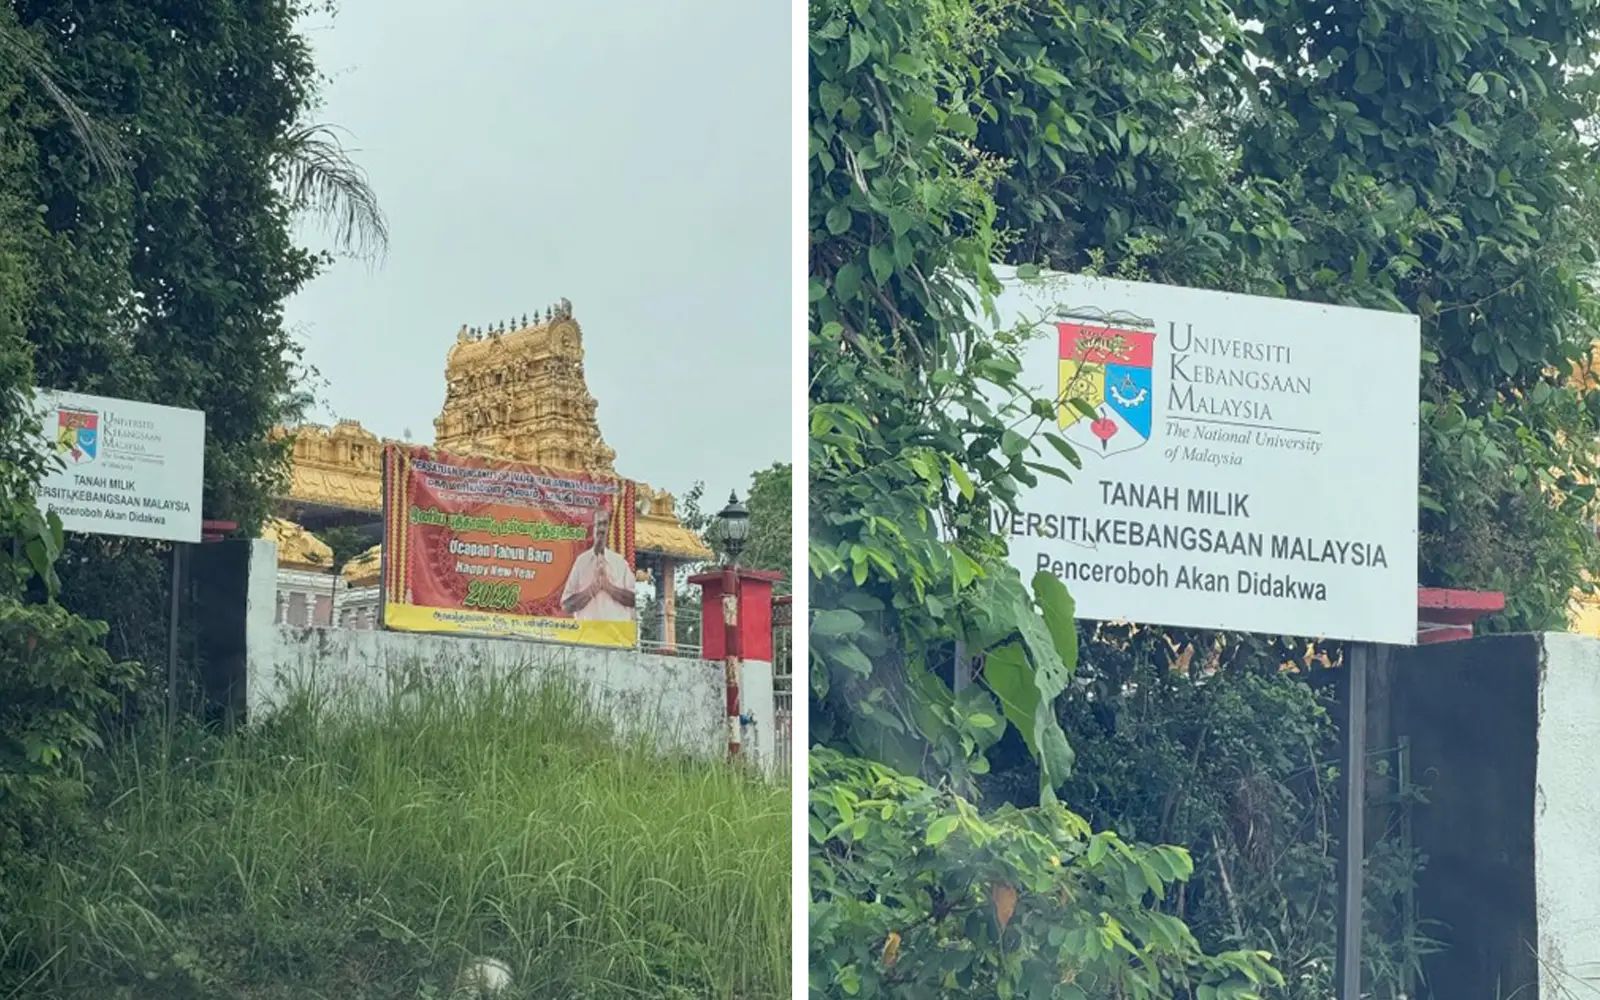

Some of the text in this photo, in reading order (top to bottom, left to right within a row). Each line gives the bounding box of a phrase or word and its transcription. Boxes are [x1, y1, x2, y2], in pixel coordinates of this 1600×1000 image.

[1168, 321, 1292, 364] UNIVERSITI
[1169, 353, 1312, 394] KEBANGSAAN
[1167, 383, 1273, 420] MALAYSIA
[1165, 421, 1323, 455] The National University
[1164, 444, 1243, 467] of Malaysia
[74, 474, 136, 491] TANAH MILIK
[1099, 480, 1251, 517] TANAH MILIK
[72, 489, 141, 507] KEBANGSAAN
[142, 499, 191, 512] MALAYSIA
[104, 509, 128, 521] Akan
[128, 510, 166, 525] Didakwa
[492, 543, 525, 560] Tahun
[527, 546, 554, 564] Baru
[1096, 518, 1264, 552] KEBANGSAAN
[1271, 535, 1389, 568] MALAYSIA
[455, 560, 536, 579] Happy New Year
[1036, 552, 1328, 601] Penceroboh Akan Didakwa
[463, 578, 522, 610] 2026
